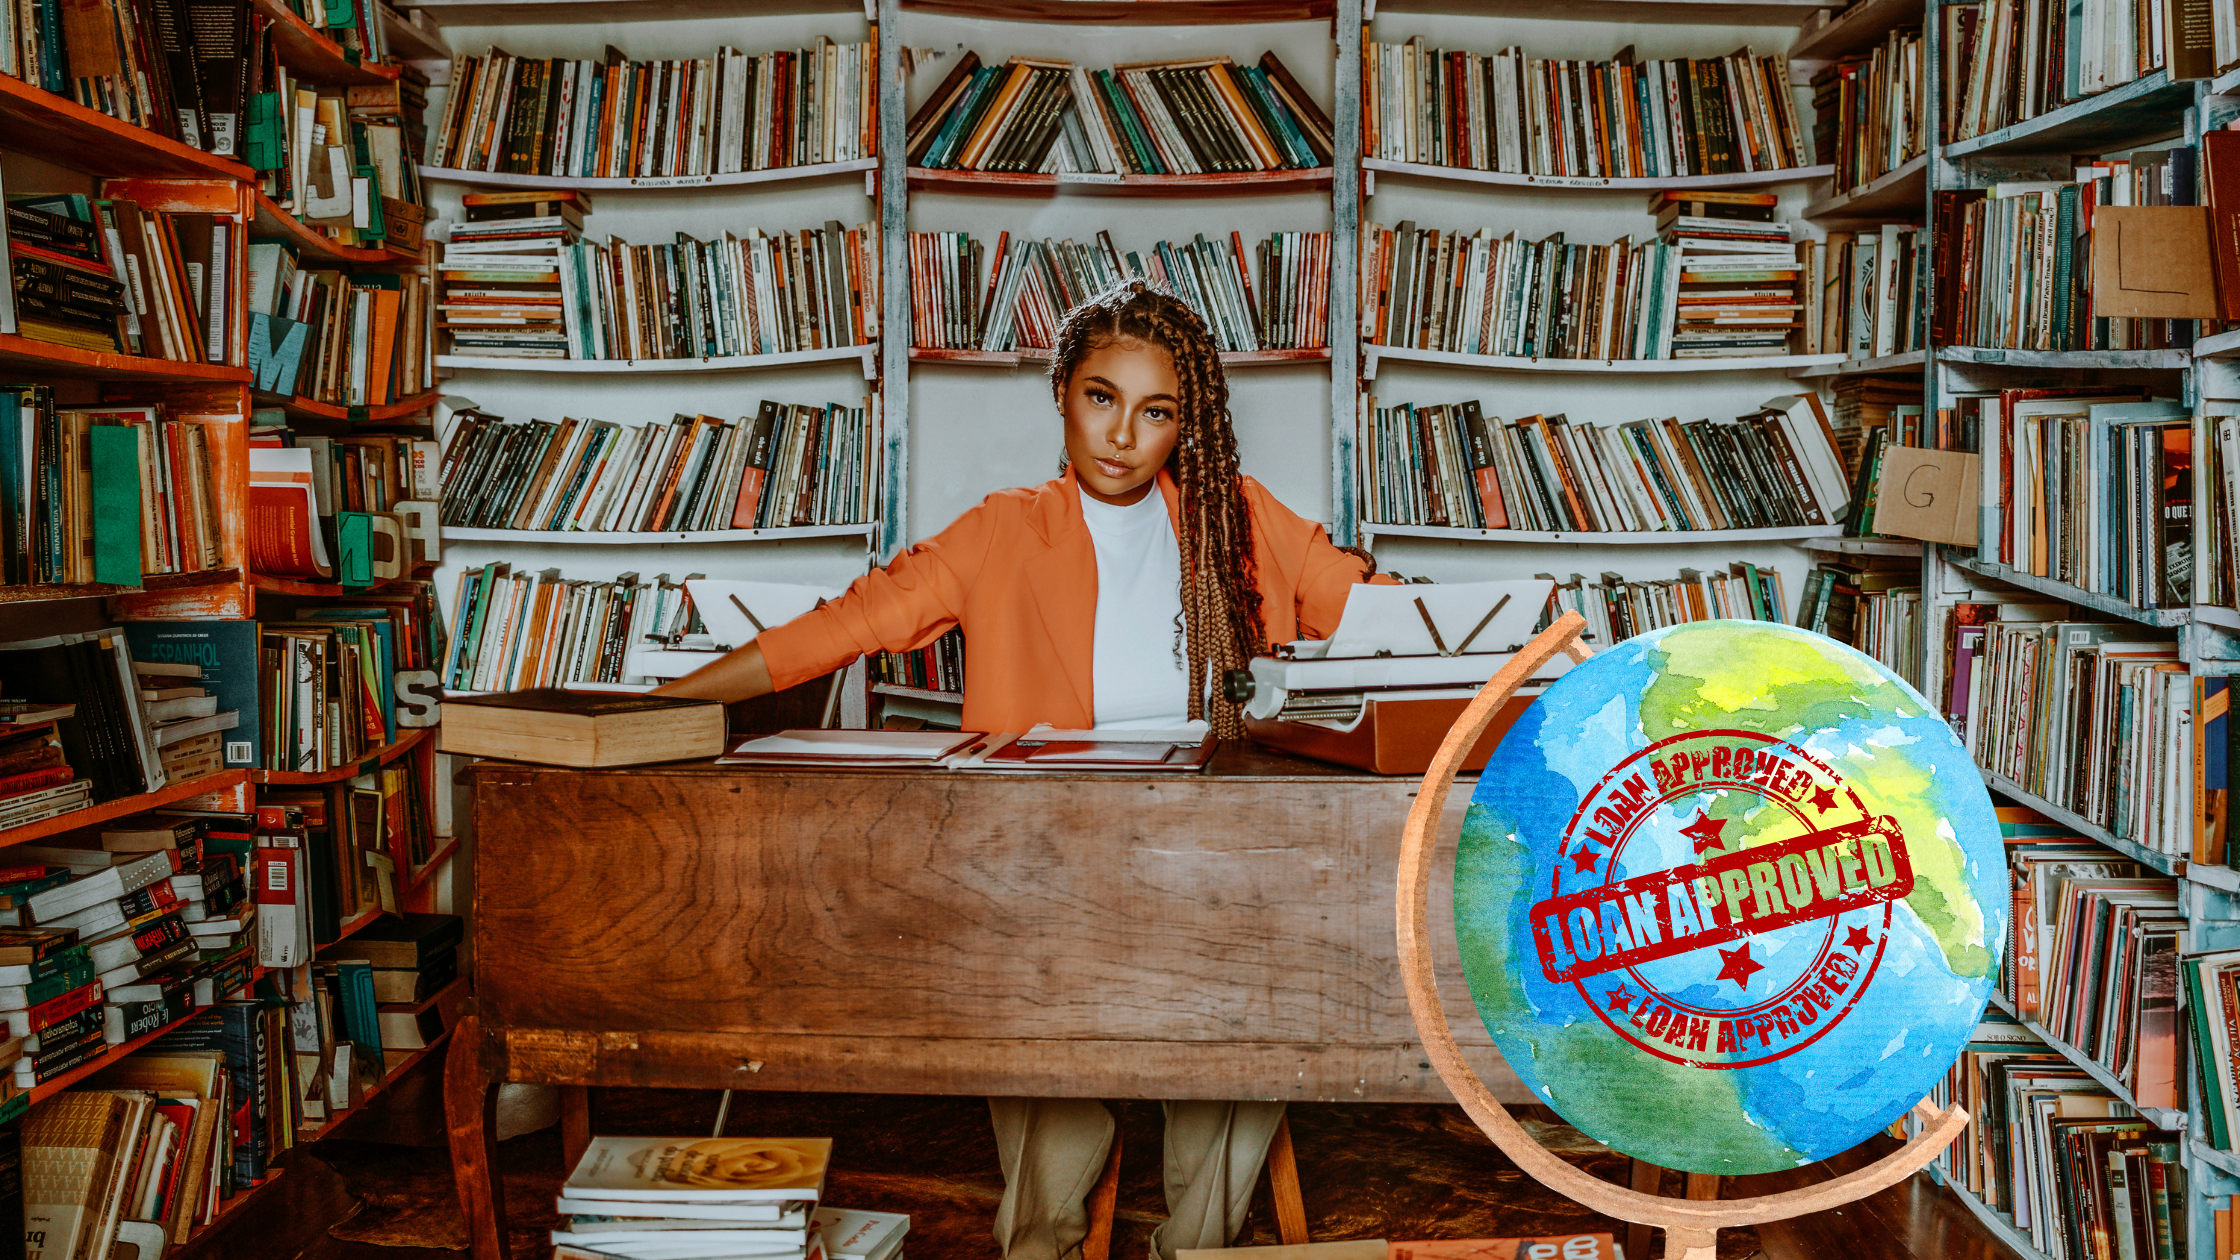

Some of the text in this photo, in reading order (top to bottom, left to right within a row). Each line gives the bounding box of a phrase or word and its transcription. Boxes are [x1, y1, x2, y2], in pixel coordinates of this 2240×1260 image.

[1371, 247, 1380, 293] ANTIPSIQUIATRIA
[2117, 220, 2190, 297] L
[1786, 460, 1811, 504] VERSOS ADVERSOS
[1903, 464, 1942, 510] G
[2165, 506, 2187, 519] O QUE
[152, 524, 161, 562] Programa
[289, 529, 297, 552] Grammar
[151, 642, 221, 668] ESPANHOL
[395, 670, 441, 728] S
[366, 850, 398, 914] T
[135, 927, 167, 951] MICHAELIS
[2220, 978, 2231, 1014] ALEXANDRE
[2007, 1034, 2026, 1042] SIGNO
[43, 1062, 69, 1078] PORTUGUESA
[256, 1009, 267, 1120] Collins
[107, 1212, 122, 1259] GRAMMAR
